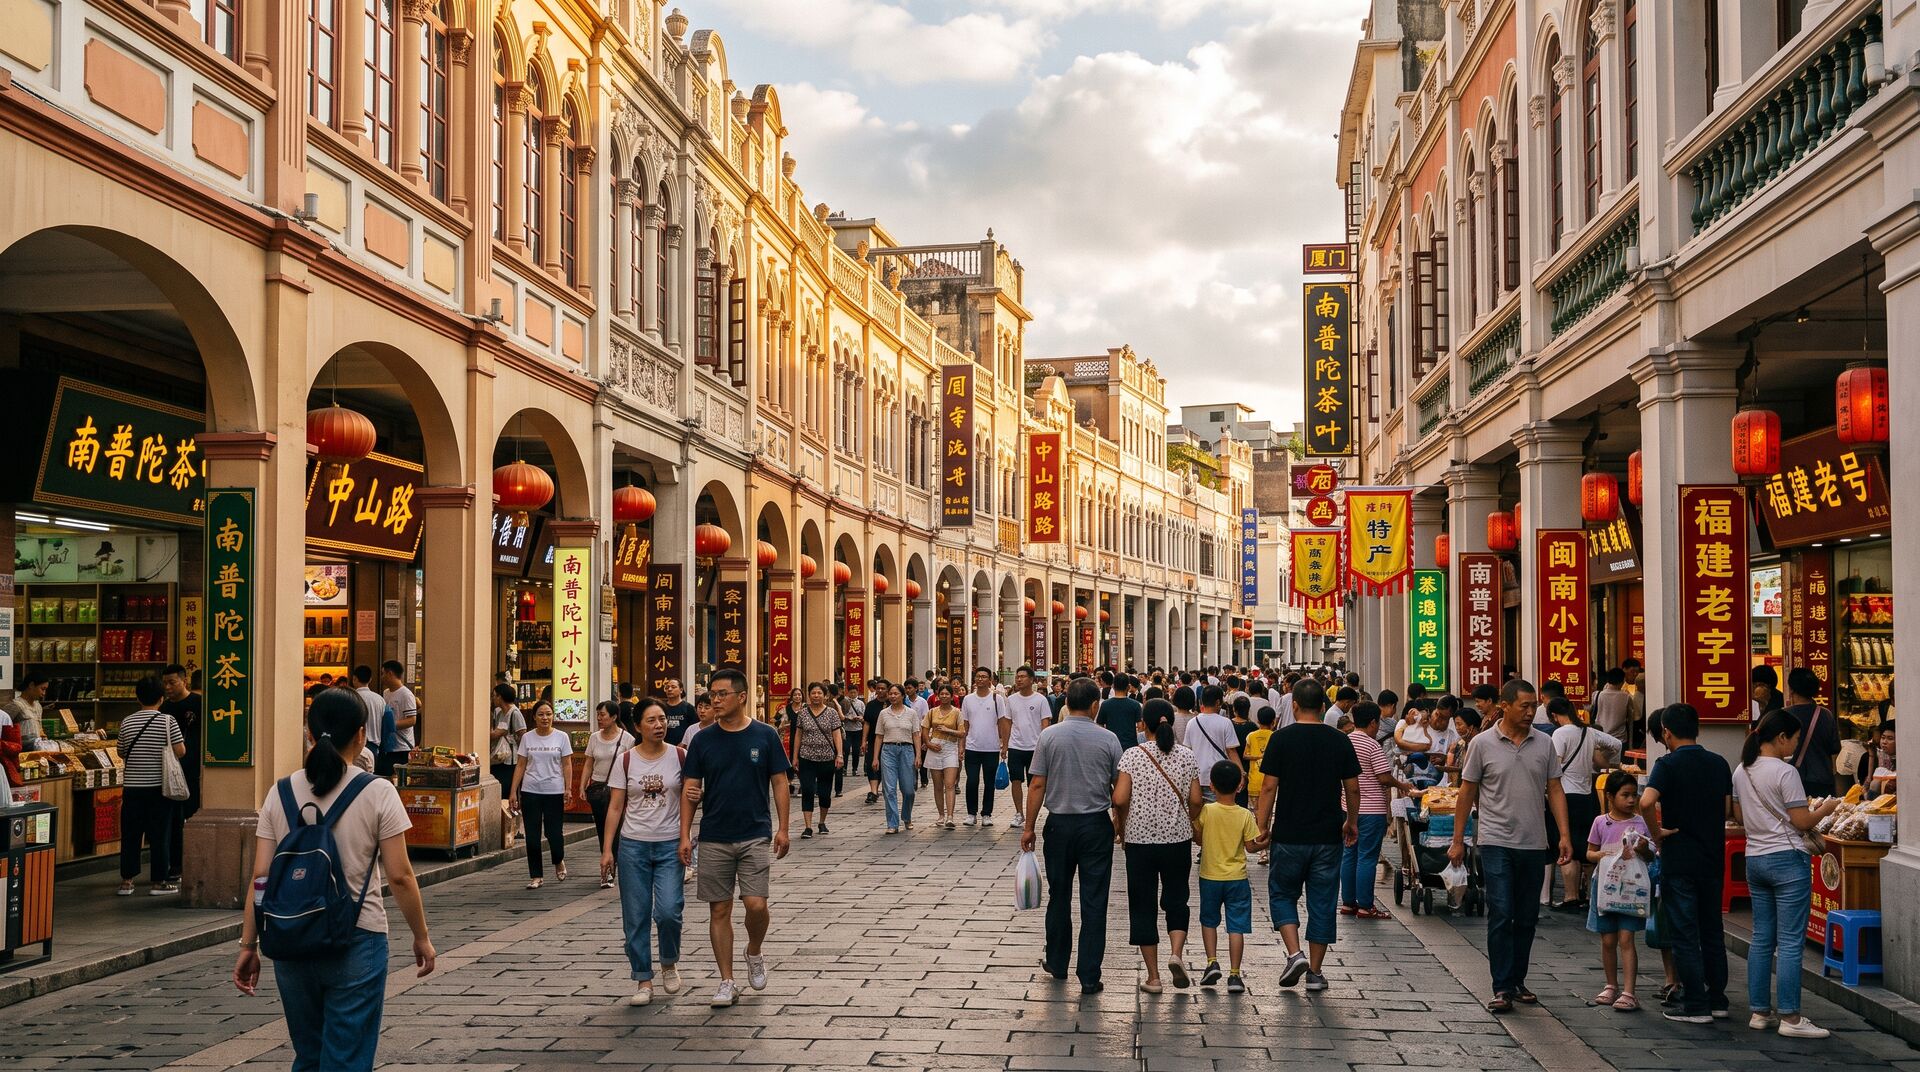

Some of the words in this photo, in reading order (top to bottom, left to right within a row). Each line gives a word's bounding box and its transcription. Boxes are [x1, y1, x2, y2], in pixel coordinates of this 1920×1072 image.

[1308, 249, 1345, 268] 厦门
[1313, 291, 1343, 446] 南普陀茶叶
[68, 415, 206, 490] 南普陀茶
[328, 463, 414, 535] 中山路
[1033, 440, 1055, 535] 中山路路
[1366, 519, 1393, 564] 特产
[211, 517, 247, 735] 南普陀茶叶
[560, 554, 583, 693] 南普陀叶小吃
[1548, 540, 1580, 666] 闽南小吃
[1694, 498, 1735, 709] 福建老字号
